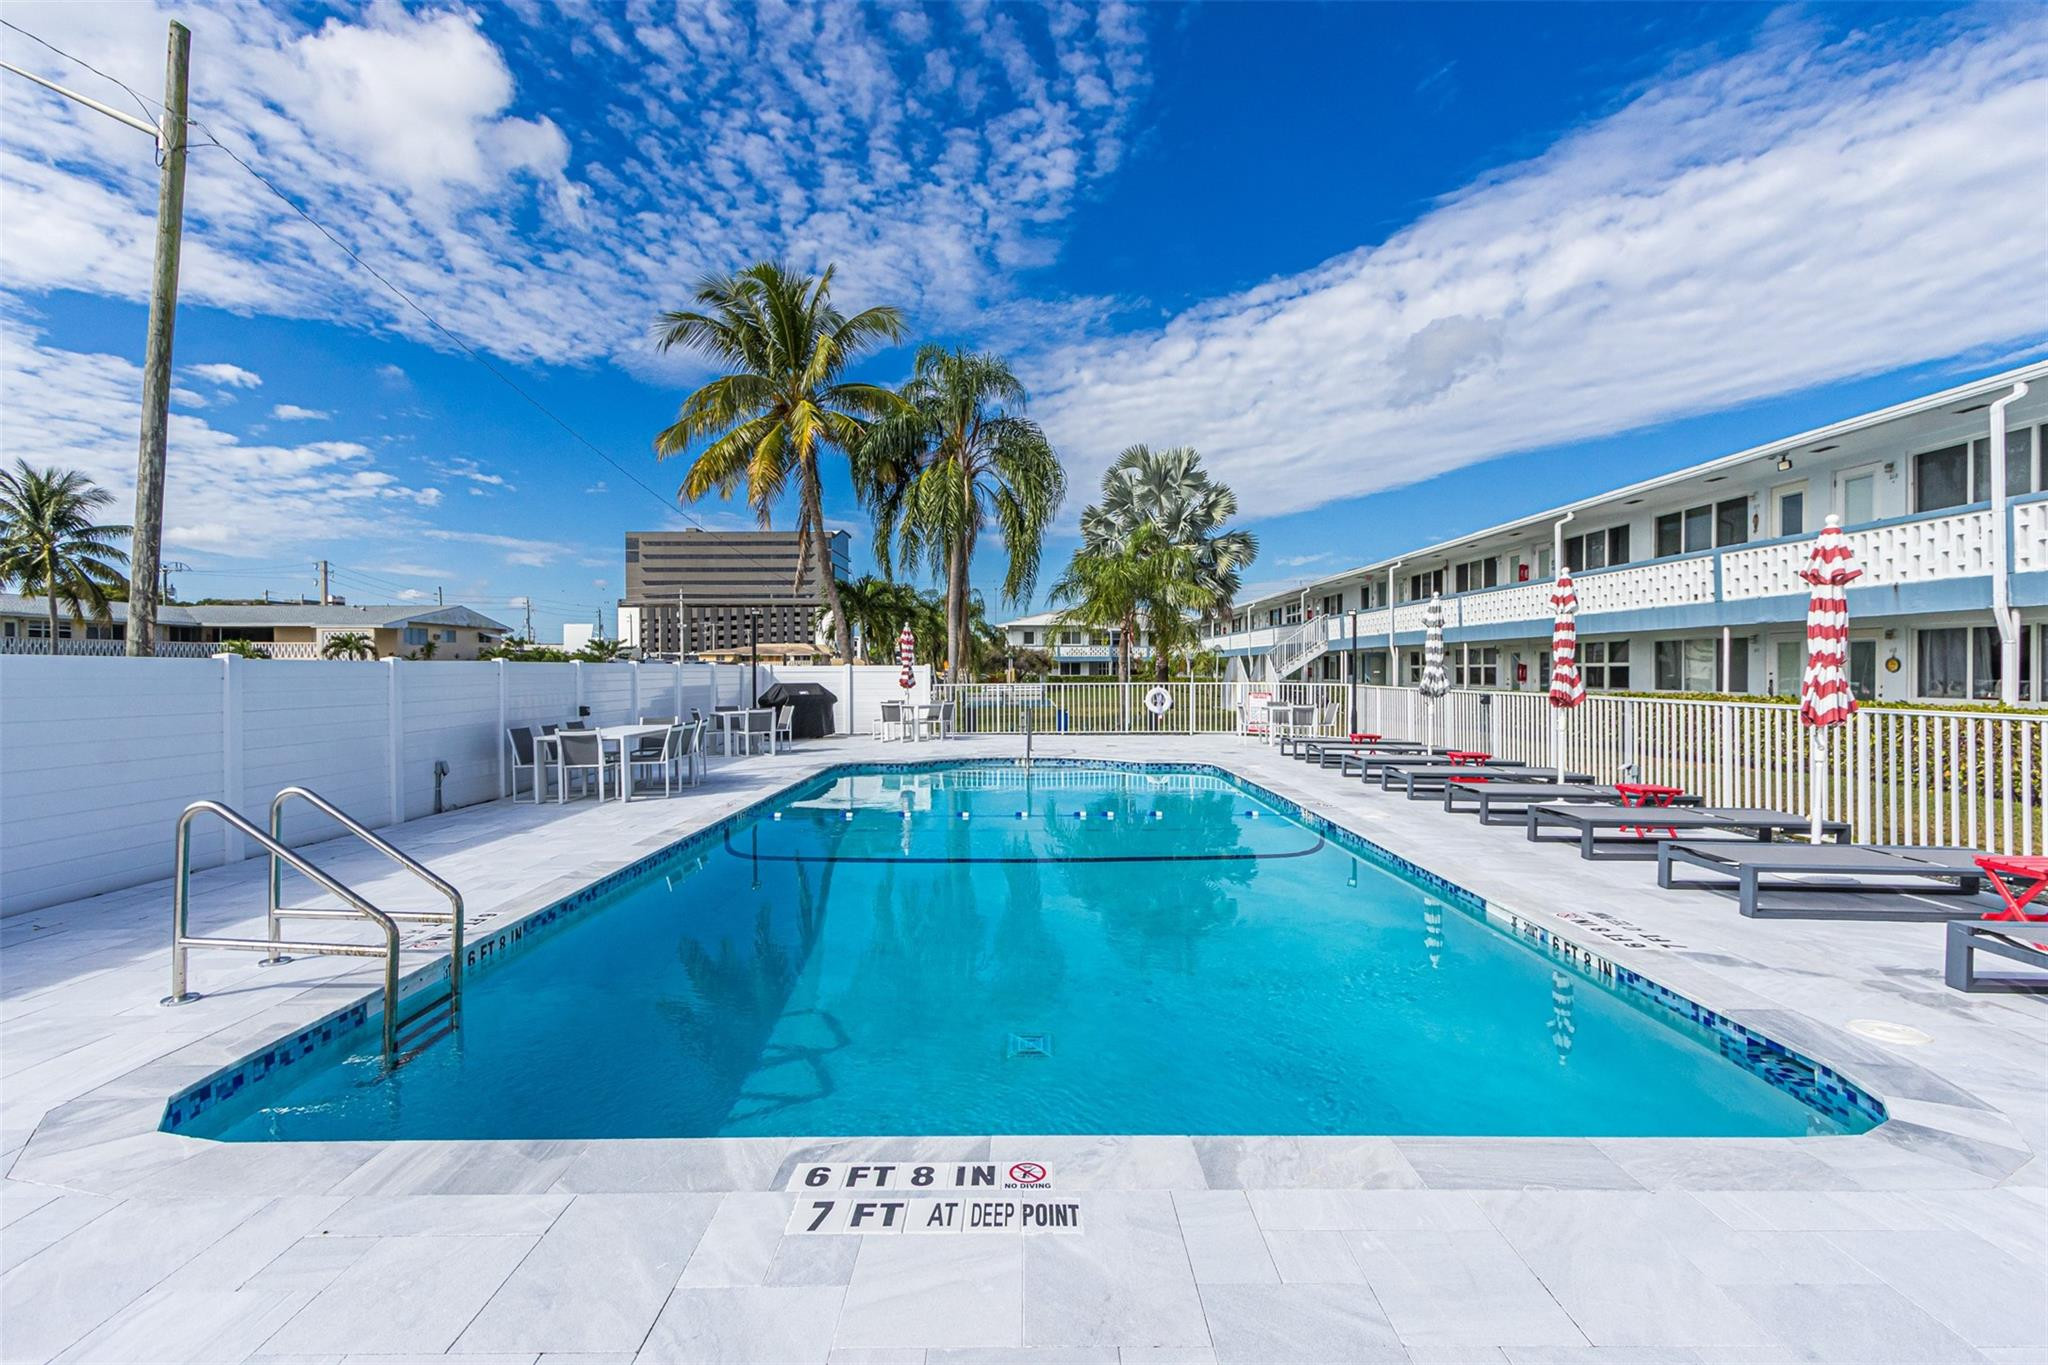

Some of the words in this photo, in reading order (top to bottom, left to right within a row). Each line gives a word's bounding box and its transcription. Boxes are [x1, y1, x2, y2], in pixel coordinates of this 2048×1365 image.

[468, 951, 476, 967] 6
[480, 940, 495, 960] FT
[500, 935, 506, 950] 8
[510, 926, 522, 943] IN
[1552, 937, 1560, 951] 6
[1564, 942, 1578, 960] FT
[1584, 952, 1591, 967] 8
[1597, 958, 1612, 977] IN
[805, 1166, 831, 1187] 6
[846, 1166, 896, 1187] FT
[910, 1166, 934, 1187] 8
[955, 1166, 996, 1187] IN
[806, 1201, 835, 1232] 7
[850, 1203, 904, 1227] FT
[927, 1203, 958, 1227] AT
[970, 1203, 1015, 1227] DEEP
[1022, 1203, 1080, 1227] POINT
